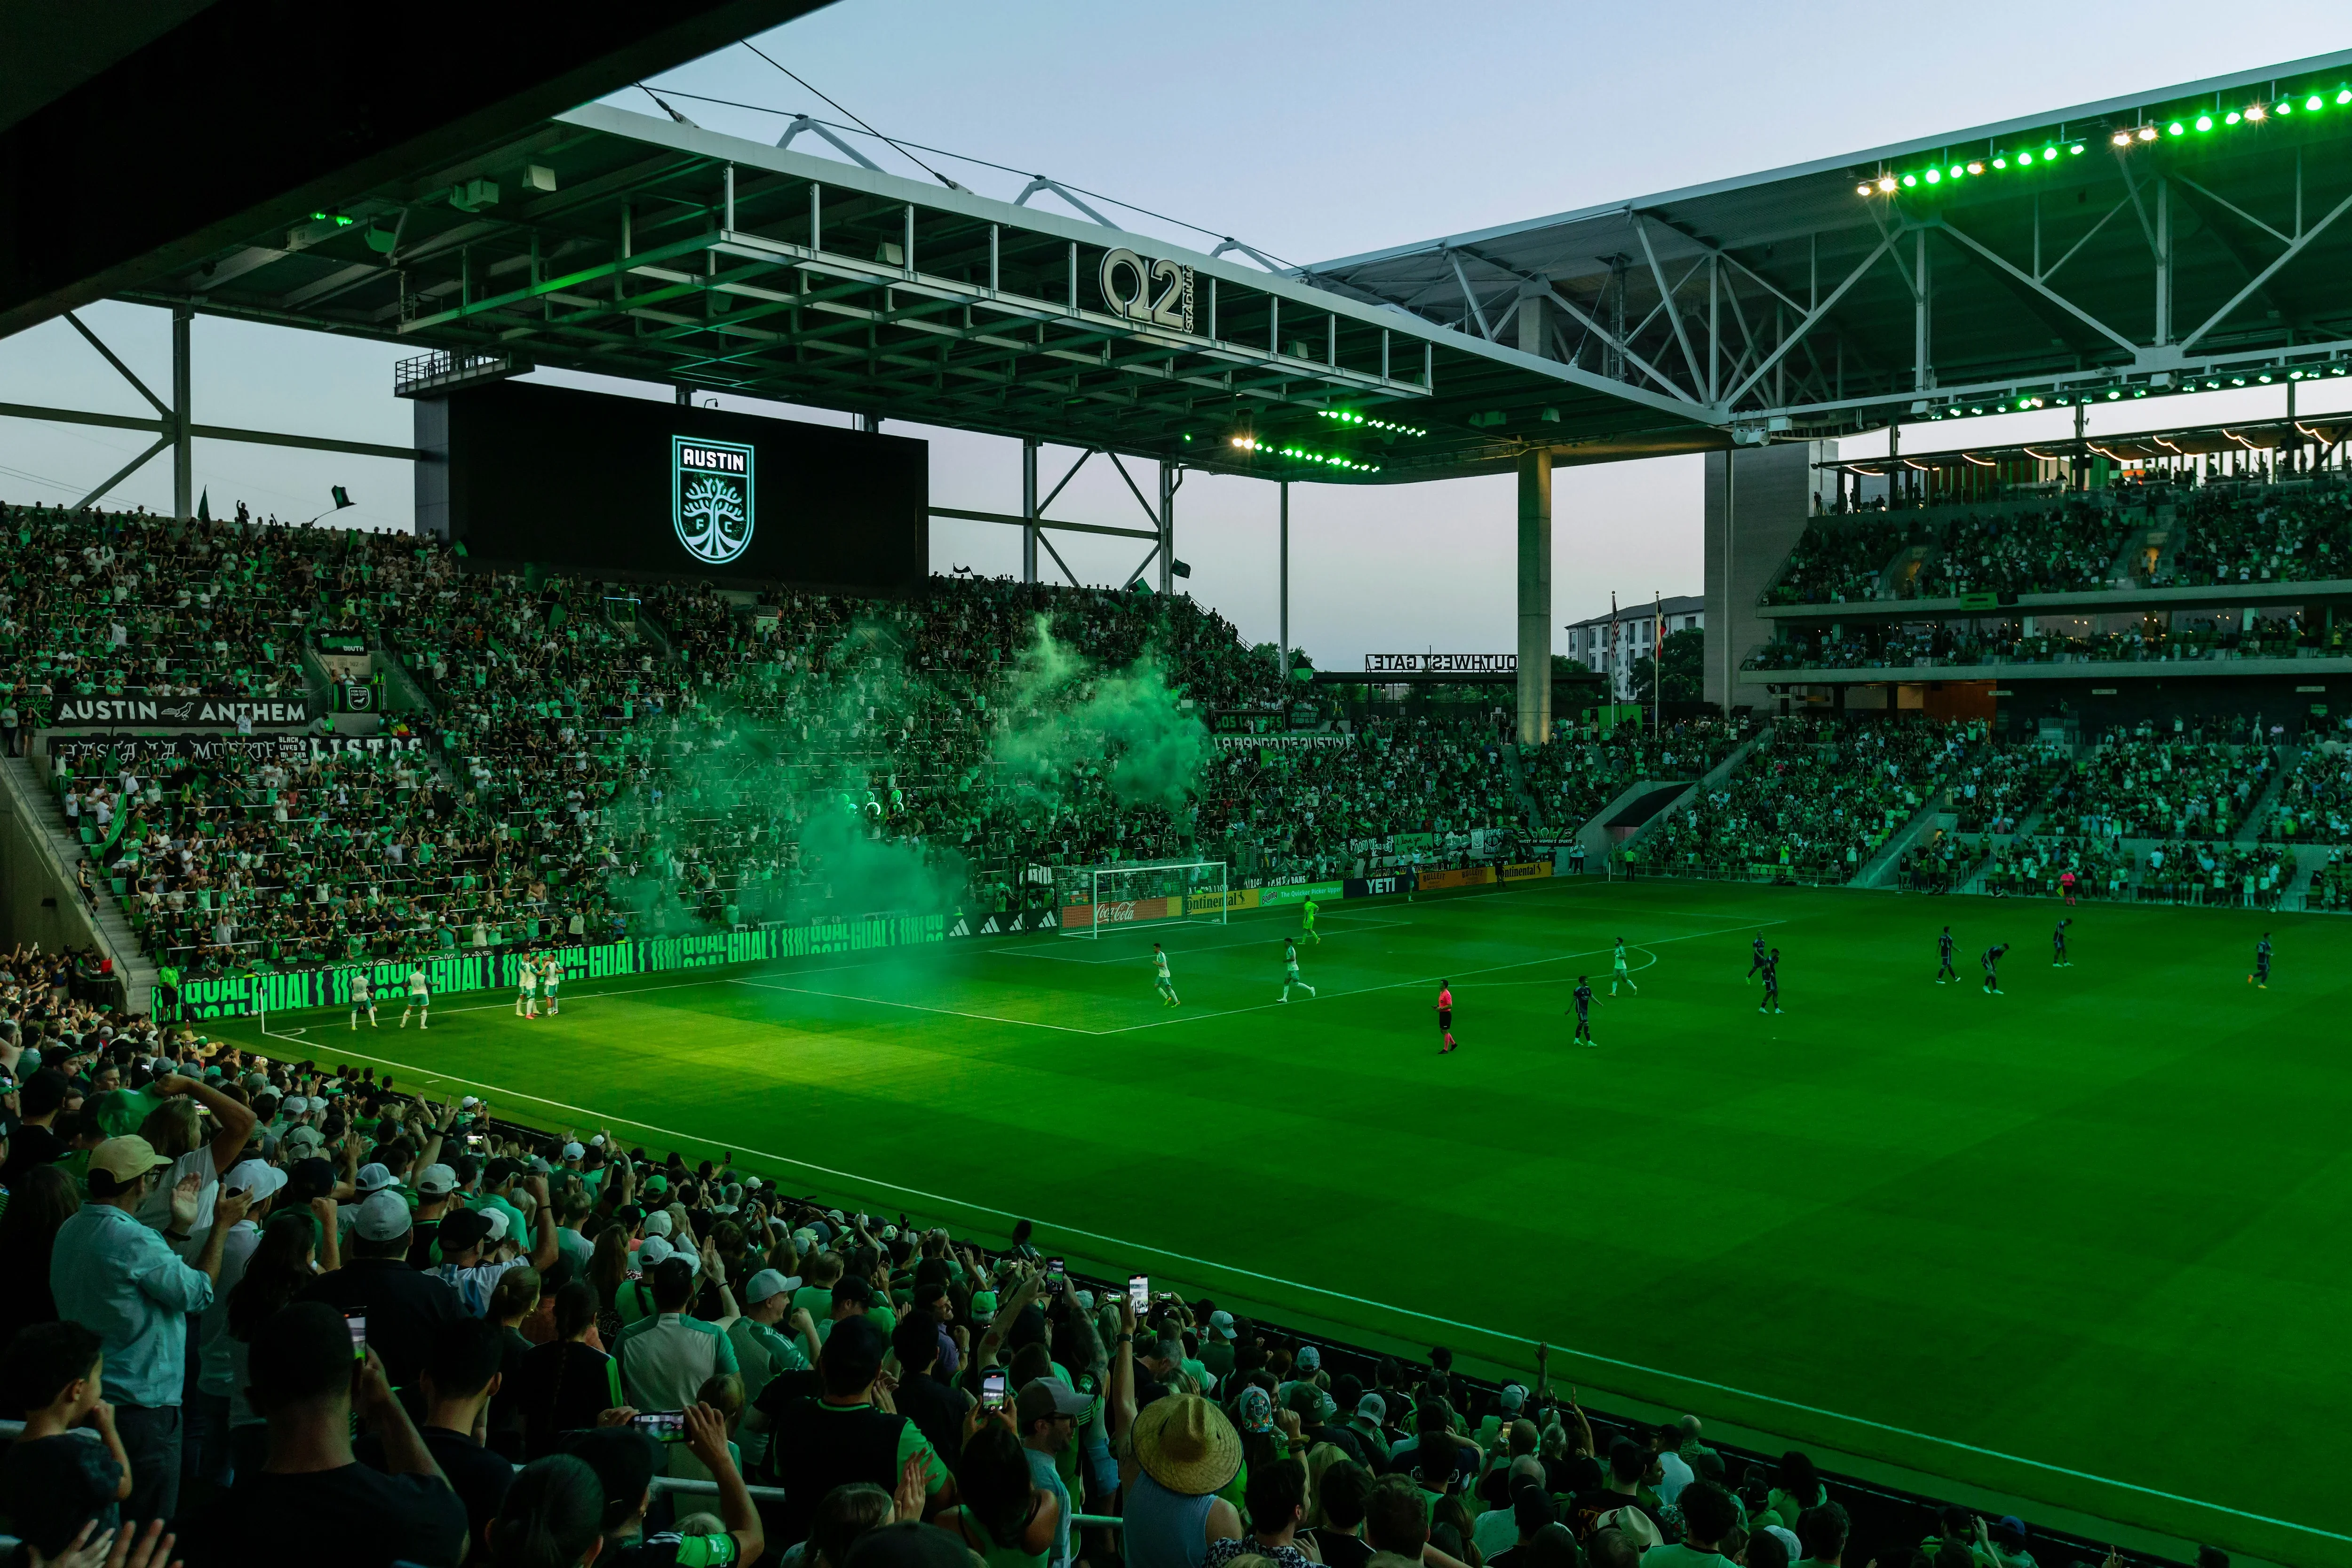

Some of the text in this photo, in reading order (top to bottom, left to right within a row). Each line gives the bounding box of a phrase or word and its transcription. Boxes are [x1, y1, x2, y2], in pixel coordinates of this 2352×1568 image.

[1099, 247, 1183, 331] Q2
[1183, 264, 1194, 334] STADIUM
[684, 448, 744, 471] AUSTIN
[696, 518, 732, 533] F C
[58, 700, 305, 721] AUSTIN ANTHEM
[1214, 737, 1232, 751] LA
[1234, 737, 1279, 751] BANDA
[1300, 736, 1344, 751] AUSTIN
[1401, 836, 1413, 845] love
[1414, 836, 1423, 846] you
[1423, 872, 1446, 882] BULLEIT
[1462, 868, 1483, 878] BULLEIT
[1502, 864, 1535, 877] ontinental
[1367, 877, 1396, 894] YETI
[1187, 893, 1237, 910] ontinental
[1262, 890, 1279, 906] Bounty
[1097, 901, 1136, 923] Coca-Cola
[851, 919, 889, 949] GOAL
[728, 930, 769, 963] GOAL
[588, 942, 637, 978] GOAL
[431, 956, 486, 995] GOAL
[253, 971, 314, 1012] GOAL
